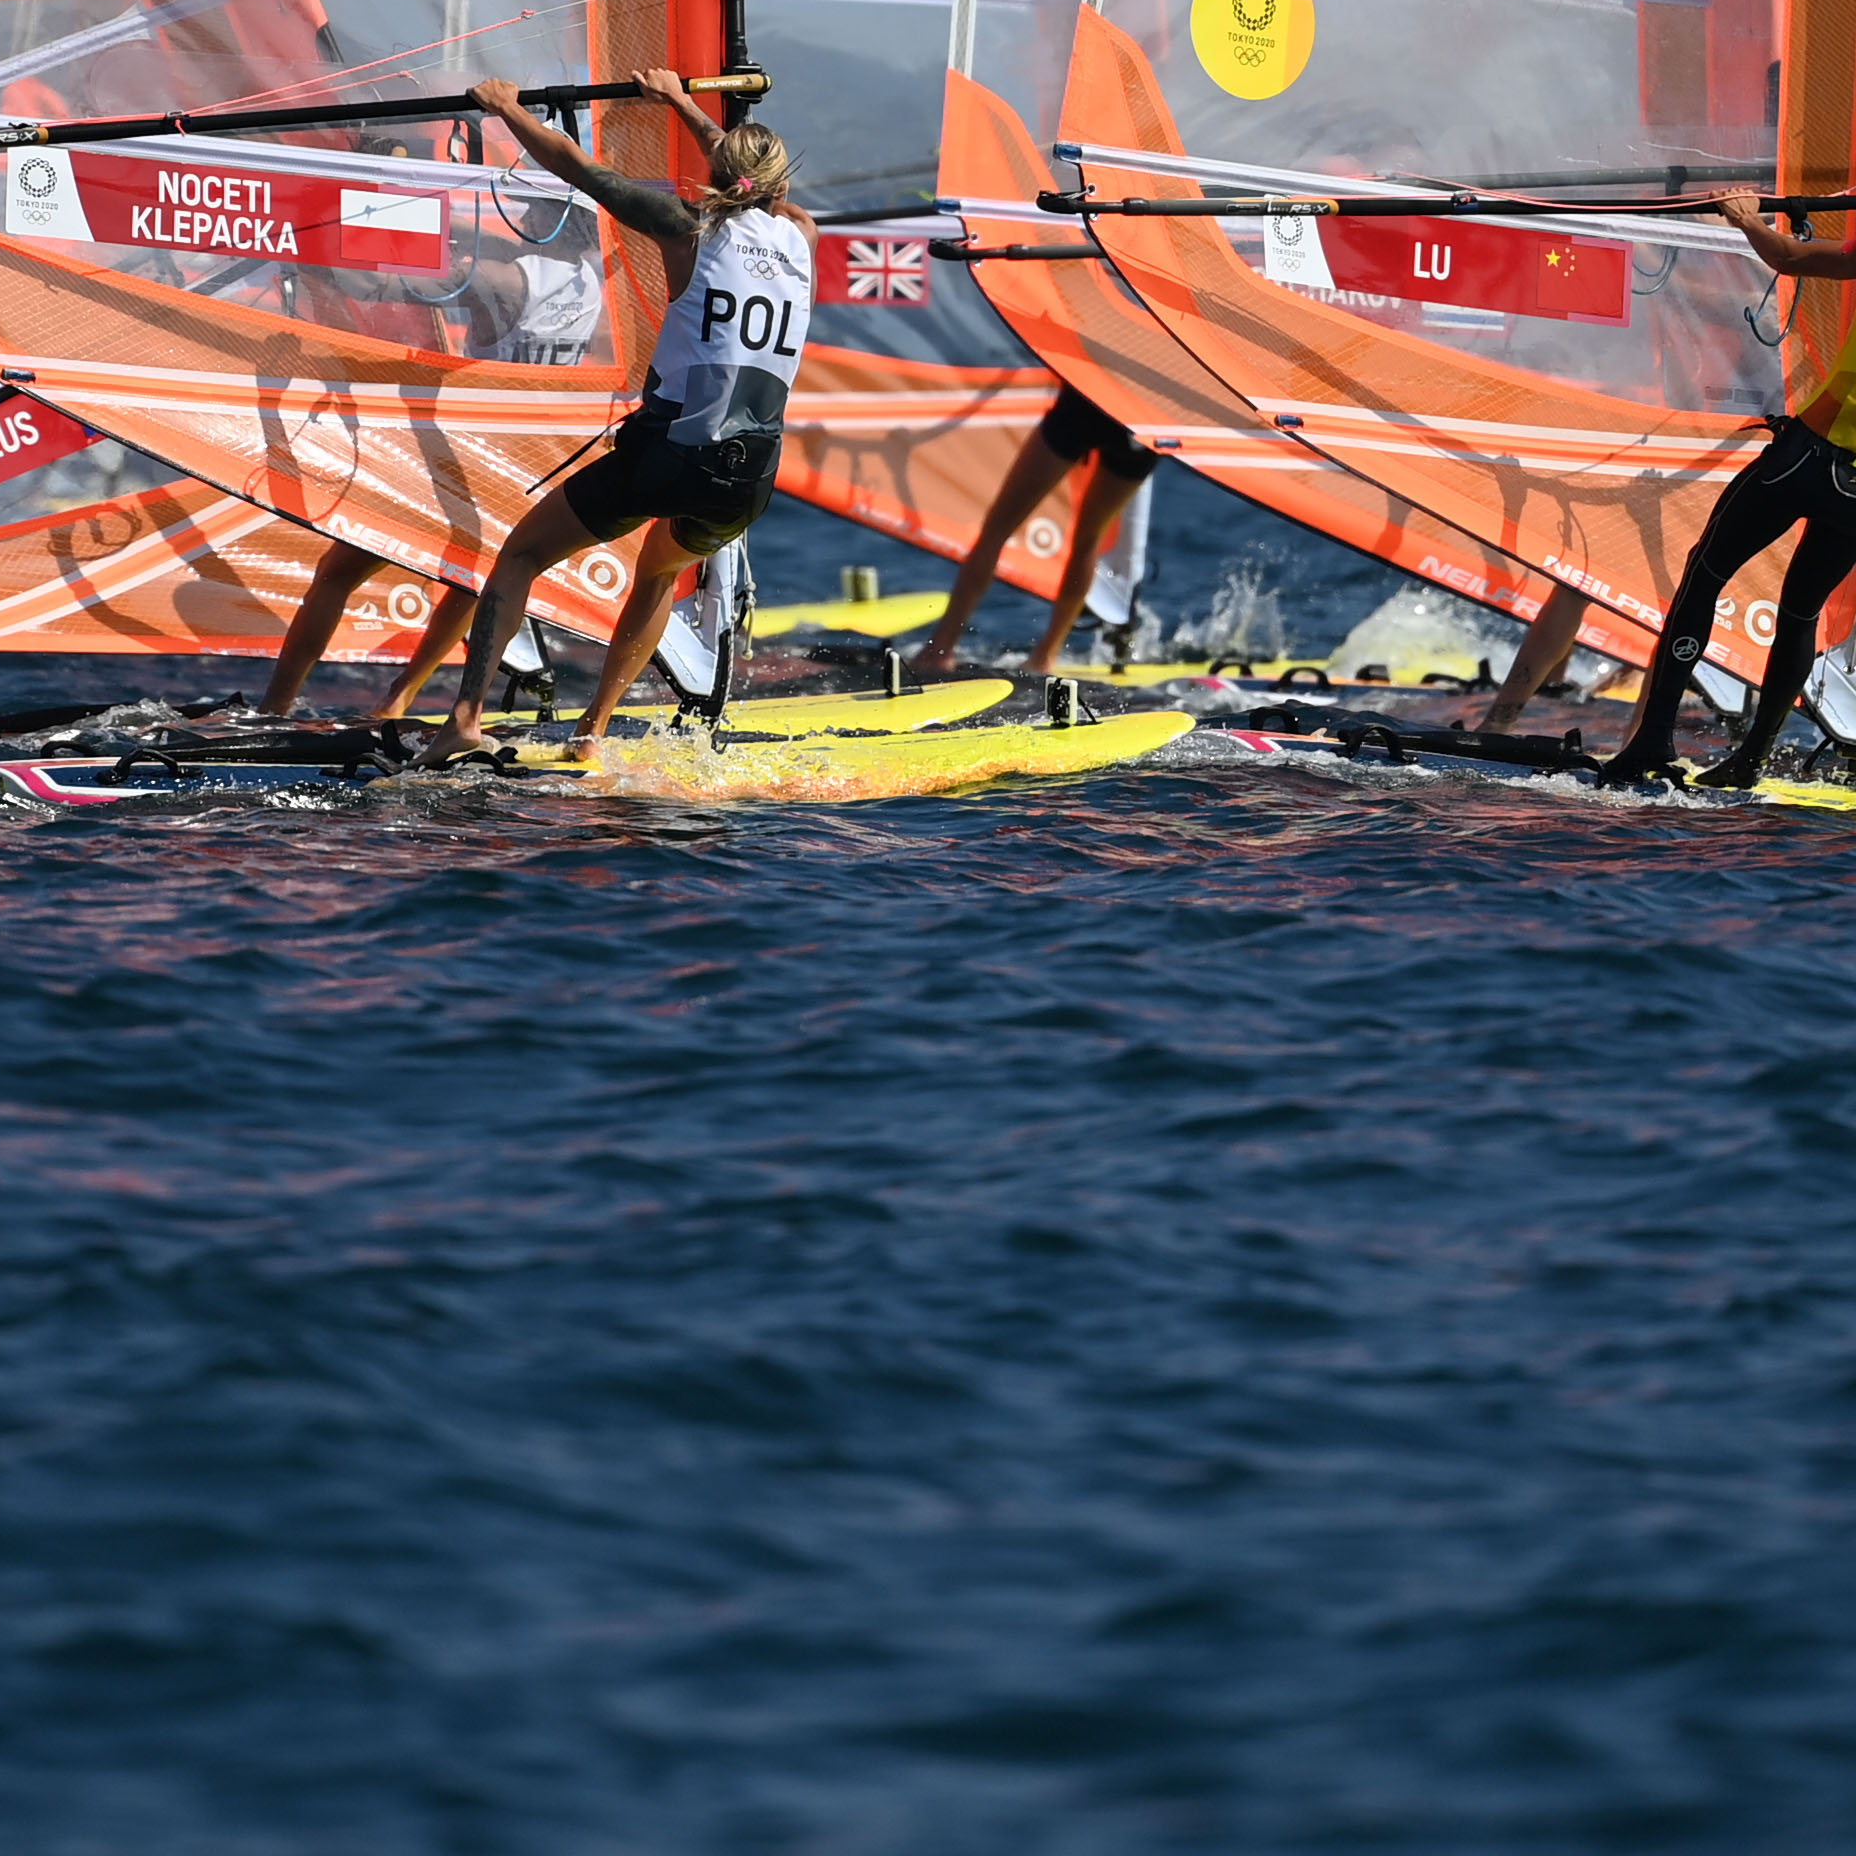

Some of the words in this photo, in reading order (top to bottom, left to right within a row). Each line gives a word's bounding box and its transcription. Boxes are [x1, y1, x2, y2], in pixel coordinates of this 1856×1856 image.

[1227, 31, 1254, 44] TOKYO
[1255, 36, 1275, 48] 2020
[16, 199, 39, 209] TOKYO
[41, 201, 59, 210] 2020
[158, 170, 271, 214] NOCETI
[131, 205, 299, 255] KLEPACKA
[736, 243, 768, 258] TOKYO
[1413, 241, 1451, 280] LU
[700, 287, 797, 357] POL
